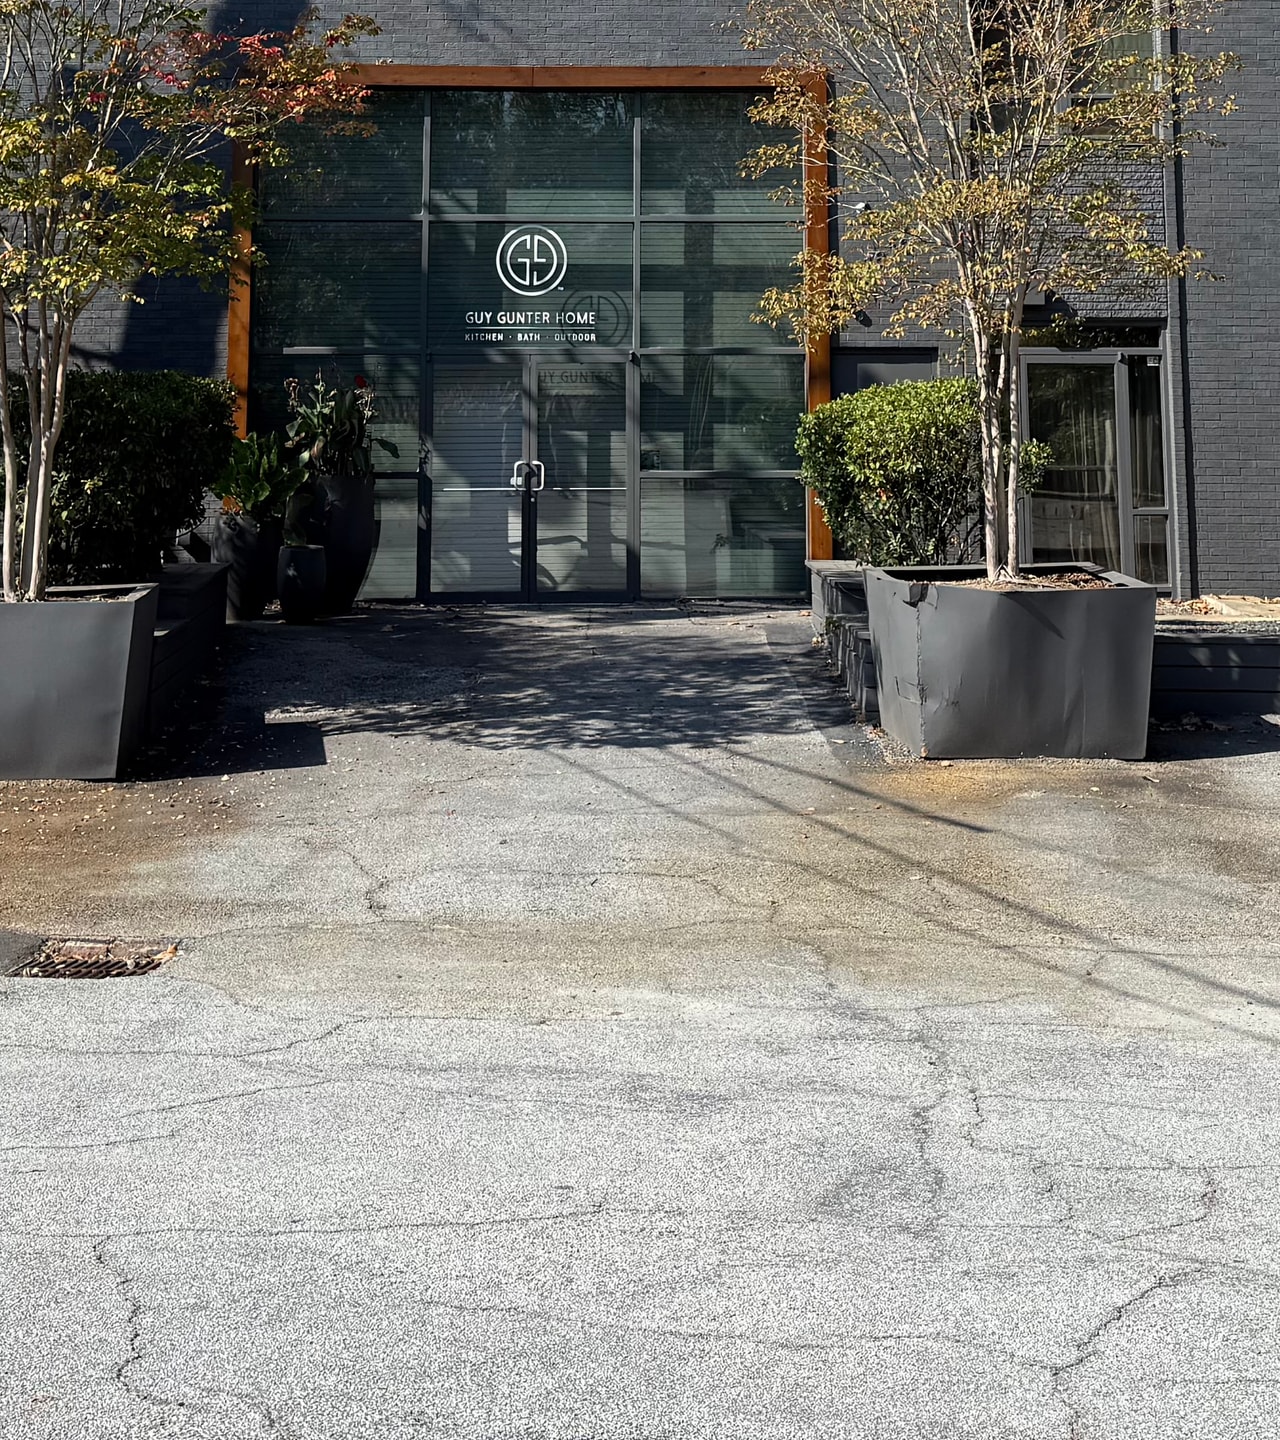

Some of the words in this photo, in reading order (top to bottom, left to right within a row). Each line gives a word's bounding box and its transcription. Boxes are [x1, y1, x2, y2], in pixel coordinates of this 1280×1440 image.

[465, 311, 493, 324] GUY
[497, 311, 550, 324] GUNTER
[555, 311, 596, 324] HOME
[464, 333, 504, 342] KITCHEN
[517, 333, 540, 342] BATH
[554, 333, 596, 342] OUTDOOR
